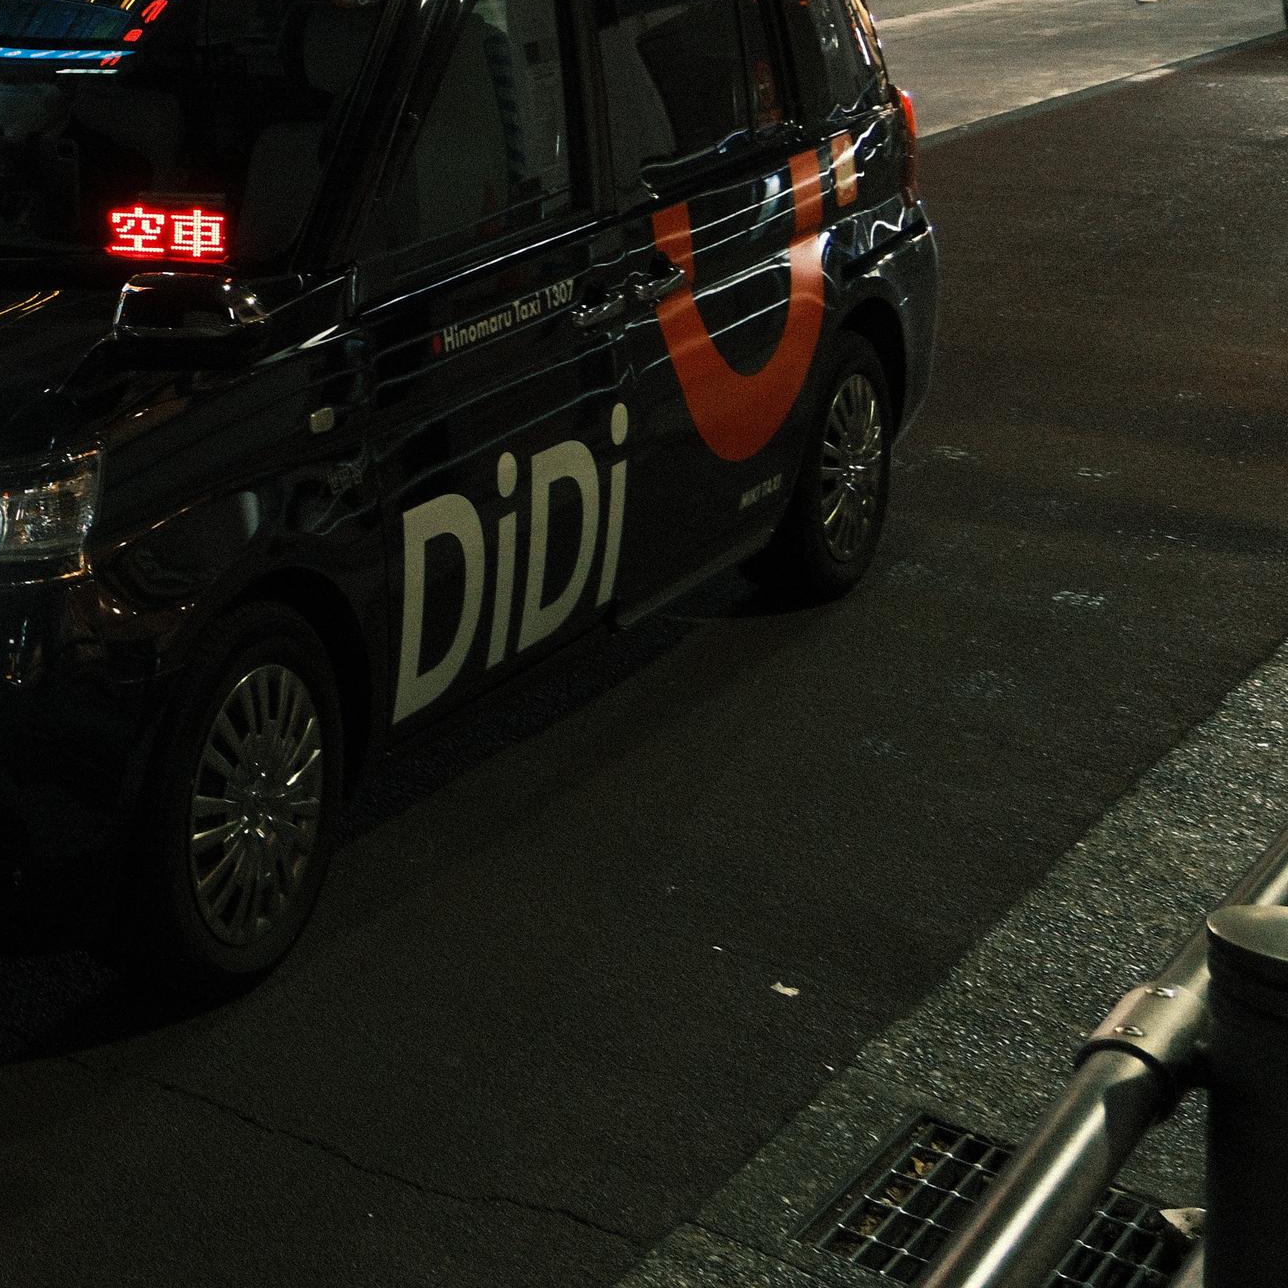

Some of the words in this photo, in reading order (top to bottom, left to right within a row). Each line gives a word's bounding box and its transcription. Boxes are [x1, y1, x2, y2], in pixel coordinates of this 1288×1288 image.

[111, 206, 225, 258] 空車
[442, 309, 513, 353] Hinomaru
[511, 290, 543, 325] Taxi
[543, 277, 575, 310] 1307
[391, 401, 630, 726] DiDi
